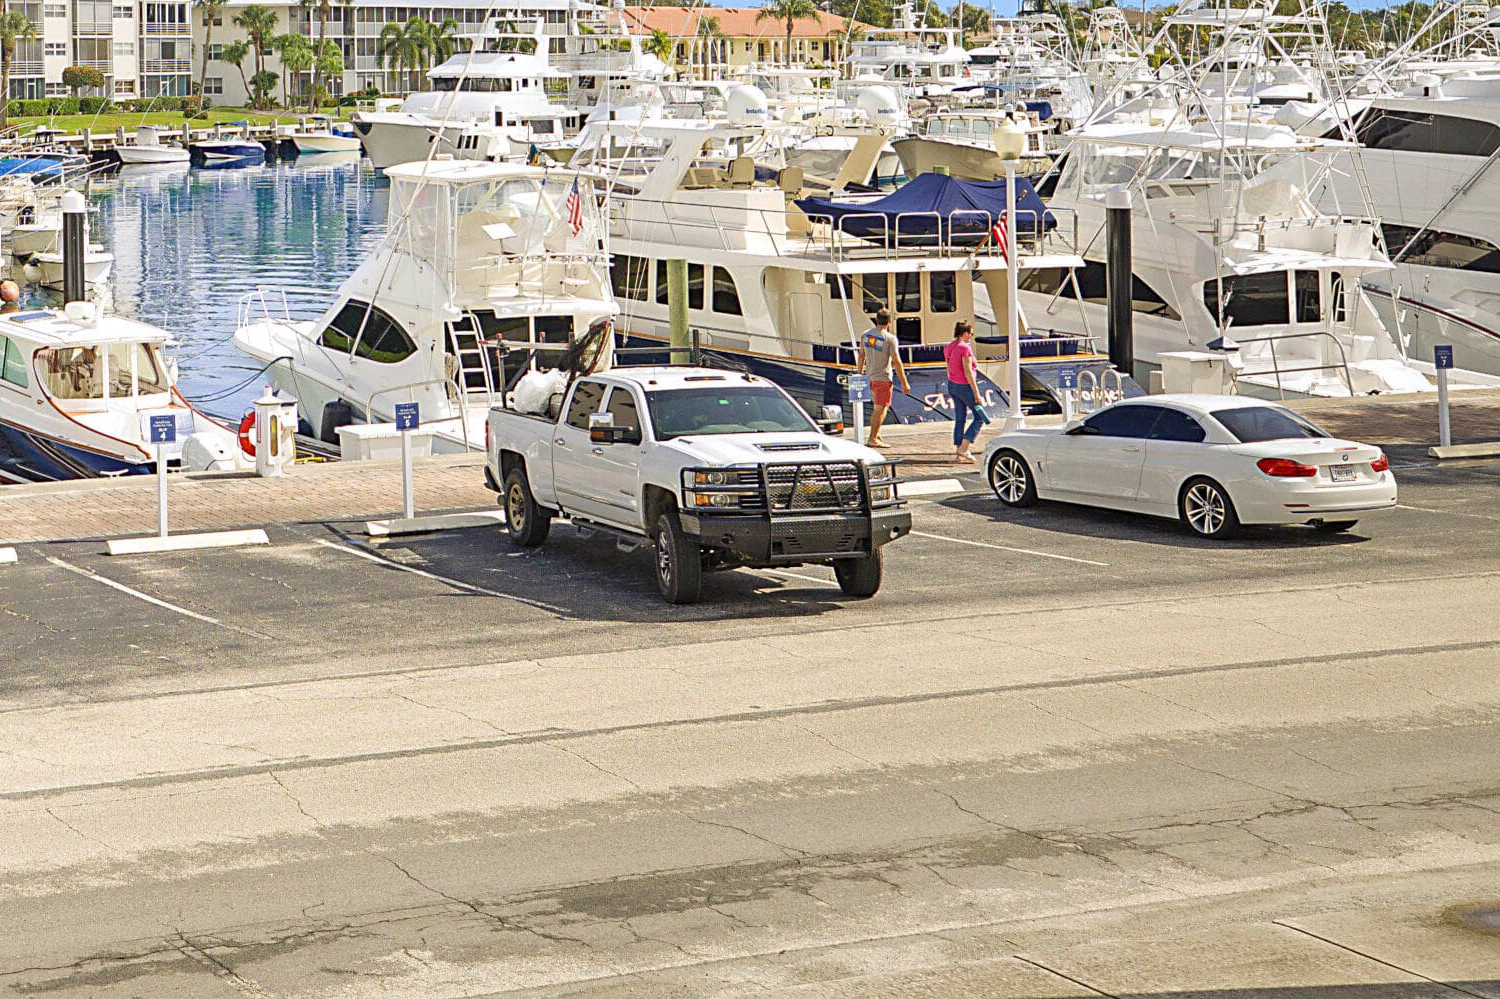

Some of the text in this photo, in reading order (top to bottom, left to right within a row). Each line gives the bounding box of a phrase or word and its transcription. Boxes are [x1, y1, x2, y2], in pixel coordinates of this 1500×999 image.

[857, 391, 863, 399] 6
[404, 419, 410, 427] 5
[160, 431, 167, 441] 4
